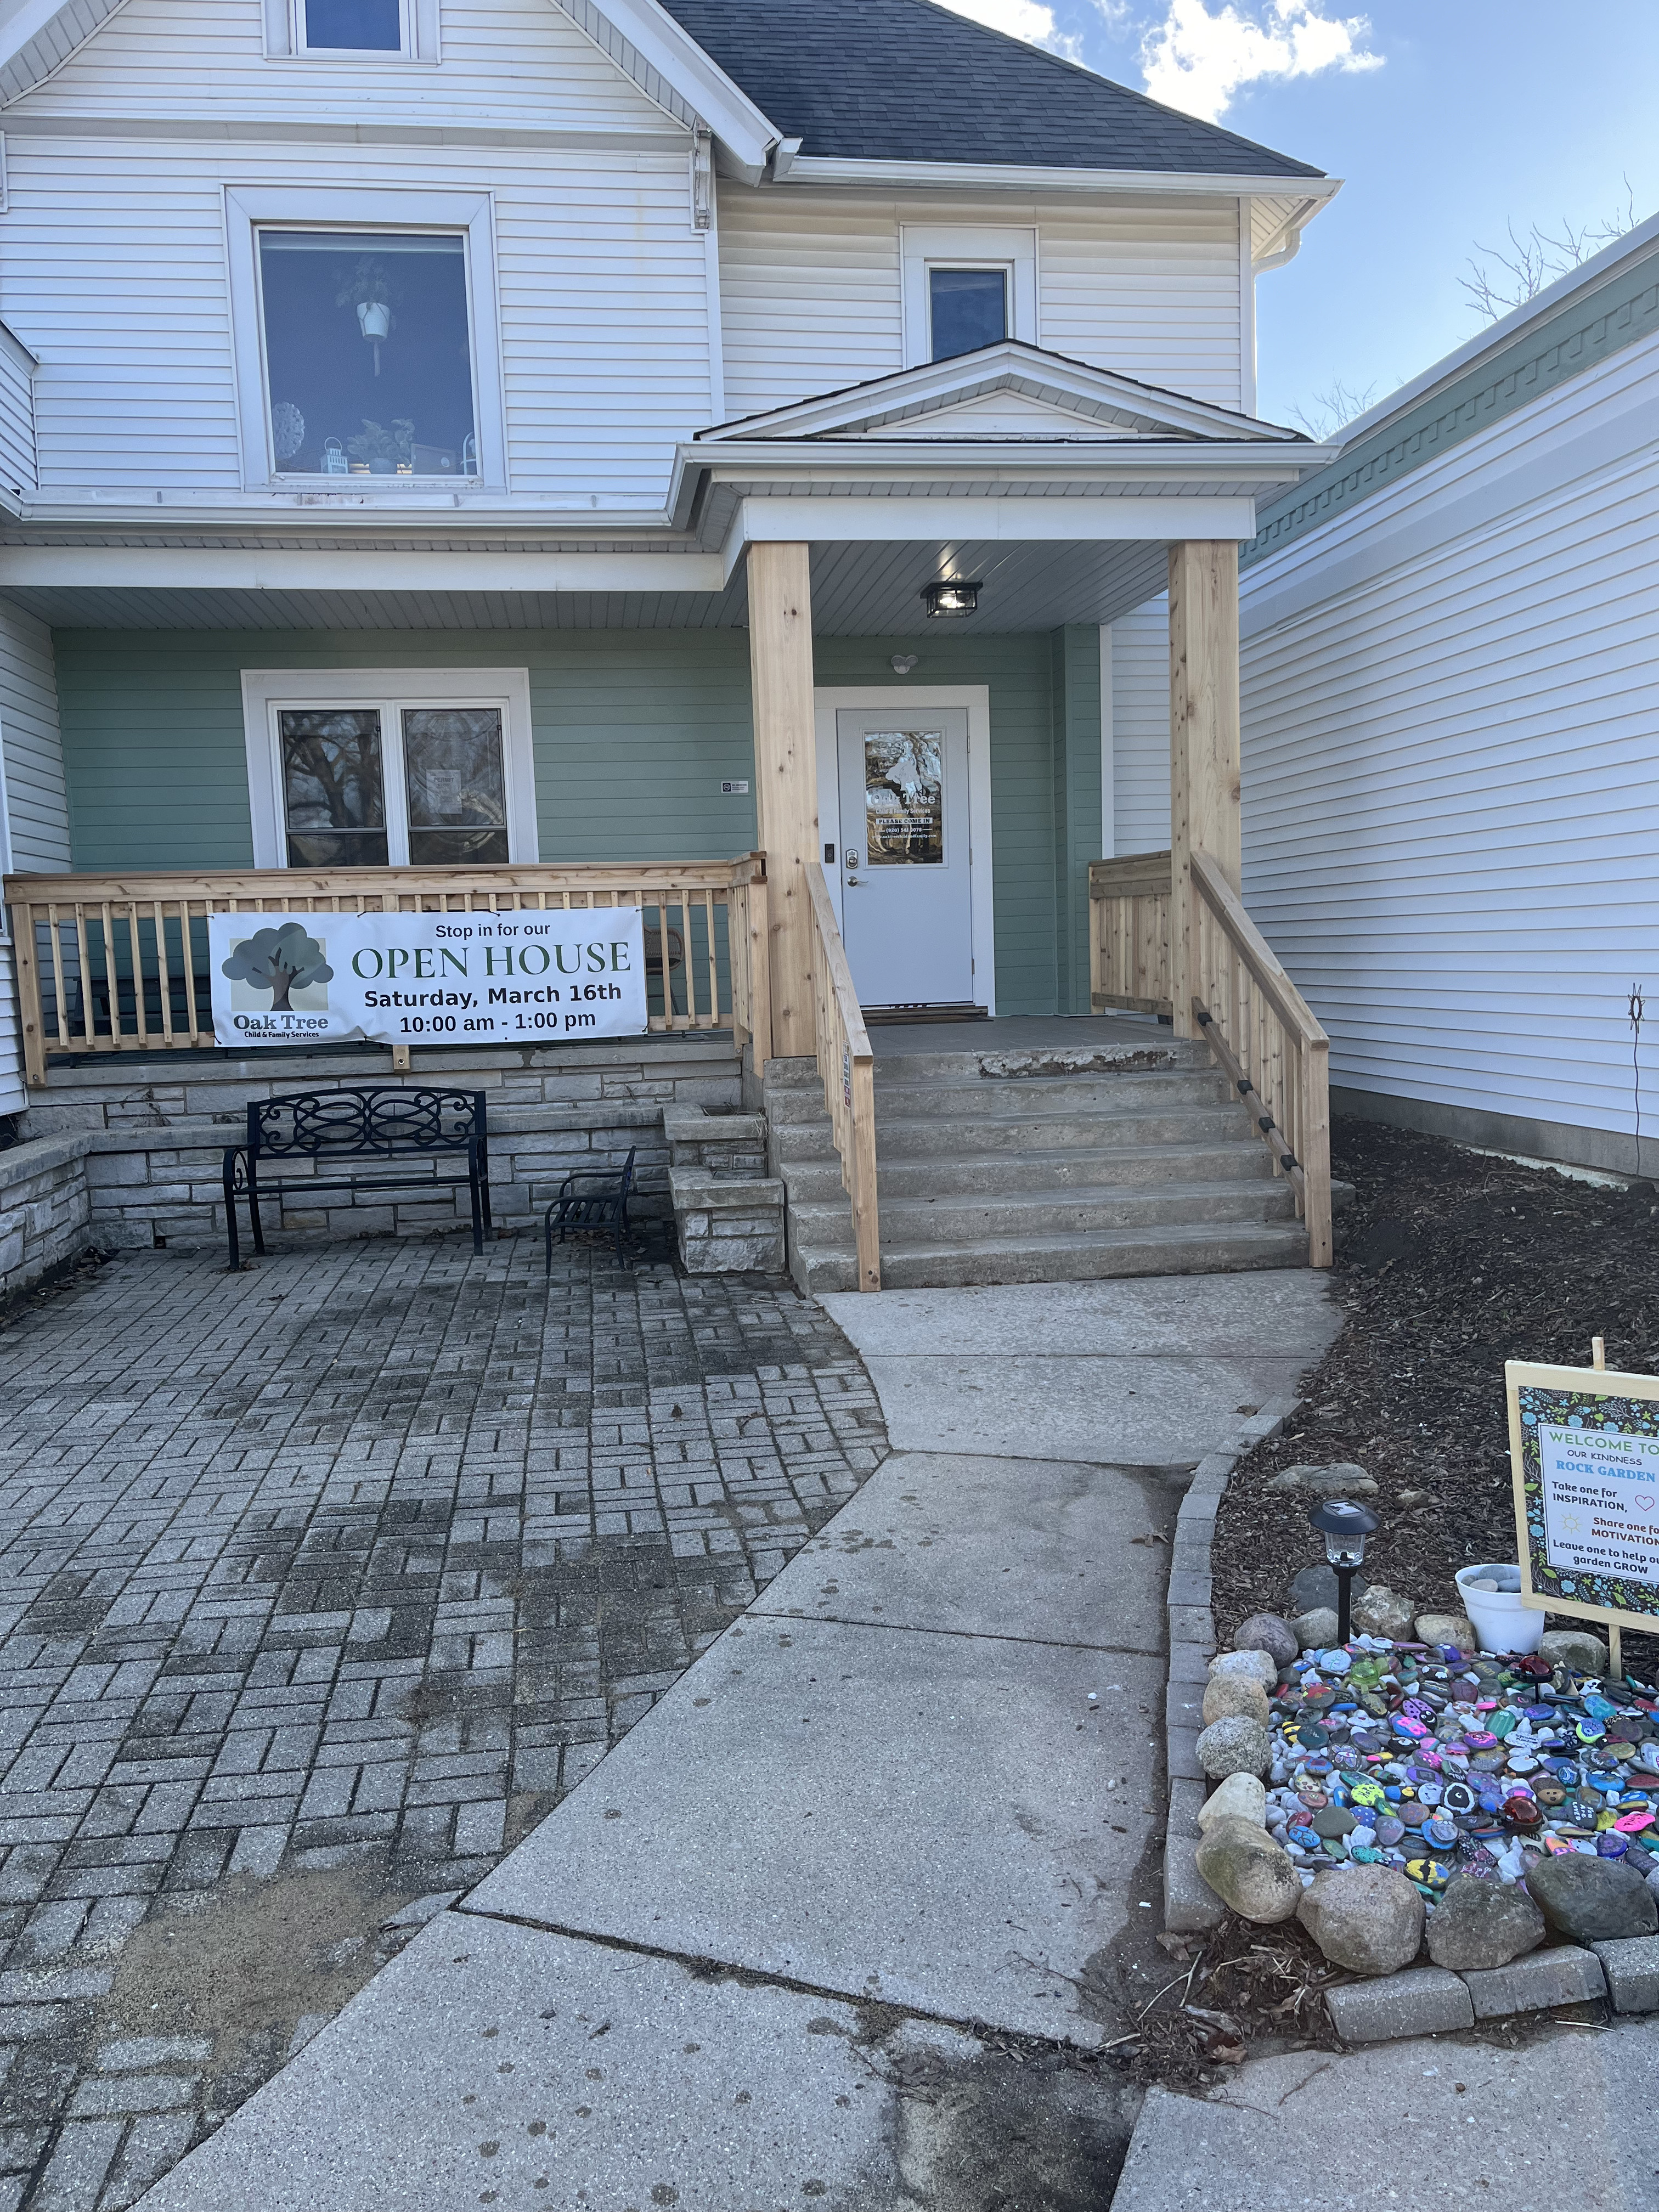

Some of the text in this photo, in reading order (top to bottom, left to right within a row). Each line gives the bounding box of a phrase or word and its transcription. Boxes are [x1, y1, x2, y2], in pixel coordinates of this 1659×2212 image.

[871, 793, 935, 805] Oak Tree
[436, 923, 550, 940] Stop in for our
[352, 942, 630, 979] OPEN HOUSE
[364, 983, 621, 1010] Saturday, March 16th
[233, 1015, 329, 1030] Oak Tree
[400, 1015, 456, 1032] 10:00
[463, 1017, 494, 1031] am
[515, 1012, 557, 1029] 1:00
[565, 1013, 596, 1031] pm
[1548, 1431, 1659, 1455] WELCOME TO
[1567, 1449, 1643, 1465] OUR KINDNESS
[1556, 1460, 1656, 1482] ROCK GARDEN
[1551, 1481, 1617, 1498] Take one for
[1553, 1493, 1628, 1513] INSPIRATION,
[1593, 1517, 1659, 1536] Share one fo
[1553, 1539, 1584, 1551] Leave
[1587, 1547, 1606, 1555] one
[1609, 1548, 1620, 1558] to
[1622, 1550, 1646, 1564] help
[1573, 1556, 1648, 1574] garden GROW
[1475, 1662, 1496, 1676] LOVE
